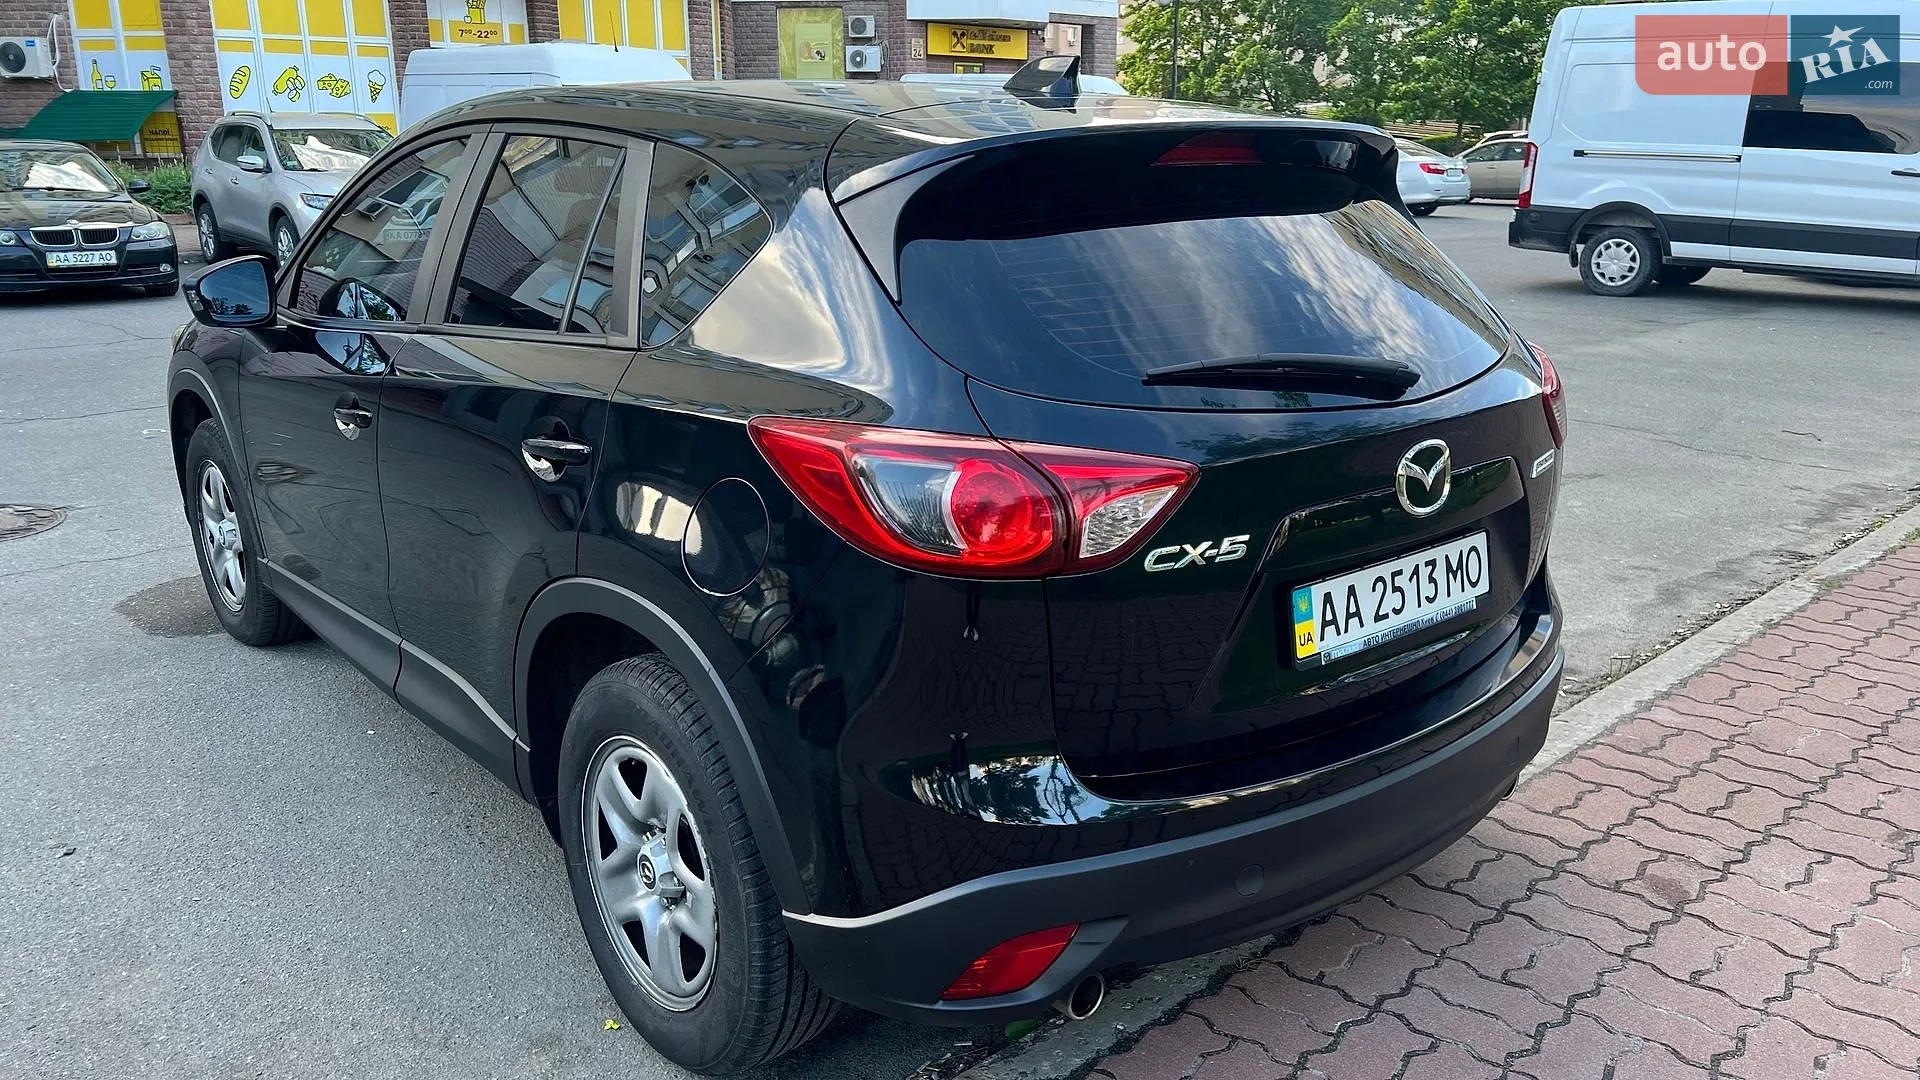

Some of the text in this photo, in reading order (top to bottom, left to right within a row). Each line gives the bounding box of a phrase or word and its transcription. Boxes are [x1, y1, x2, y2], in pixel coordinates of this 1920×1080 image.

[913, 48, 922, 58] 24
[73, 253, 95, 263] 5227
[1144, 534, 1251, 572] CX-5
[1319, 544, 1482, 643] AA 2513 MO
[1298, 630, 1315, 647] UA
